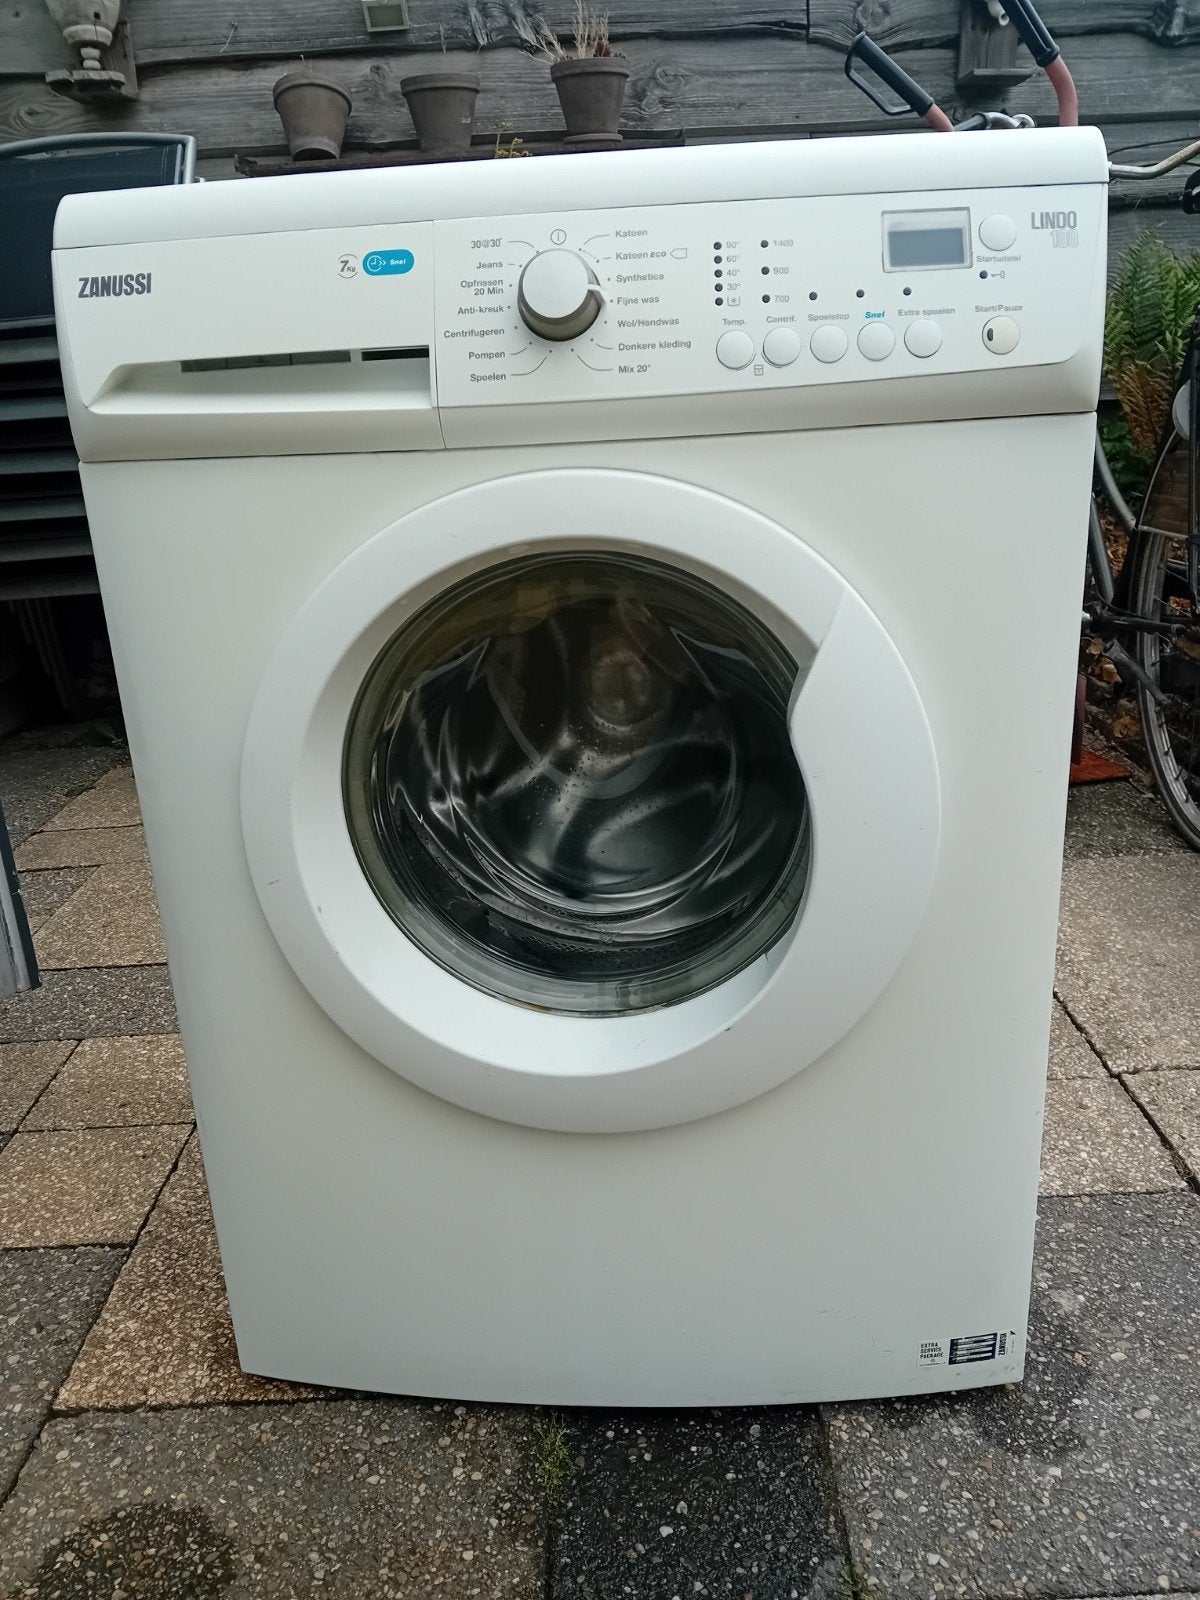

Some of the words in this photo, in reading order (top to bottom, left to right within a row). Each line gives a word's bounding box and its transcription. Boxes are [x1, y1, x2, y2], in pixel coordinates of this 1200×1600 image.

[1031, 211, 1078, 230] LINDO
[615, 229, 648, 238] Katoen
[773, 239, 794, 247] 1400
[1050, 229, 1079, 248] 100
[615, 252, 649, 260] Katoen
[976, 254, 1021, 263] Startuitstel
[390, 258, 406, 266] Snel
[476, 261, 503, 270] Jeans
[773, 266, 789, 274] 900
[616, 273, 664, 284] Synthetica
[78, 273, 152, 298] ZANUSSI
[460, 279, 504, 289] Opfrissen
[474, 288, 485, 296] 20
[487, 287, 504, 295] Min
[616, 296, 639, 307] Fijne
[641, 296, 660, 304] was
[774, 295, 790, 303] 700
[457, 305, 504, 315] Anti-kreuk
[898, 309, 920, 317] Extra
[923, 306, 956, 317] spoelen
[974, 304, 1023, 313] Start/Pauze
[808, 313, 850, 322] Spoelstop
[864, 310, 885, 319] Snel
[617, 318, 680, 328] Wol/Handwas
[722, 318, 747, 326] Temp.
[443, 328, 505, 339] Centrifugeren
[618, 342, 656, 352] Donkere
[658, 340, 692, 350] kleding
[468, 351, 506, 361] Pompen
[618, 365, 634, 374] Mix
[470, 372, 507, 383] Spoelen
